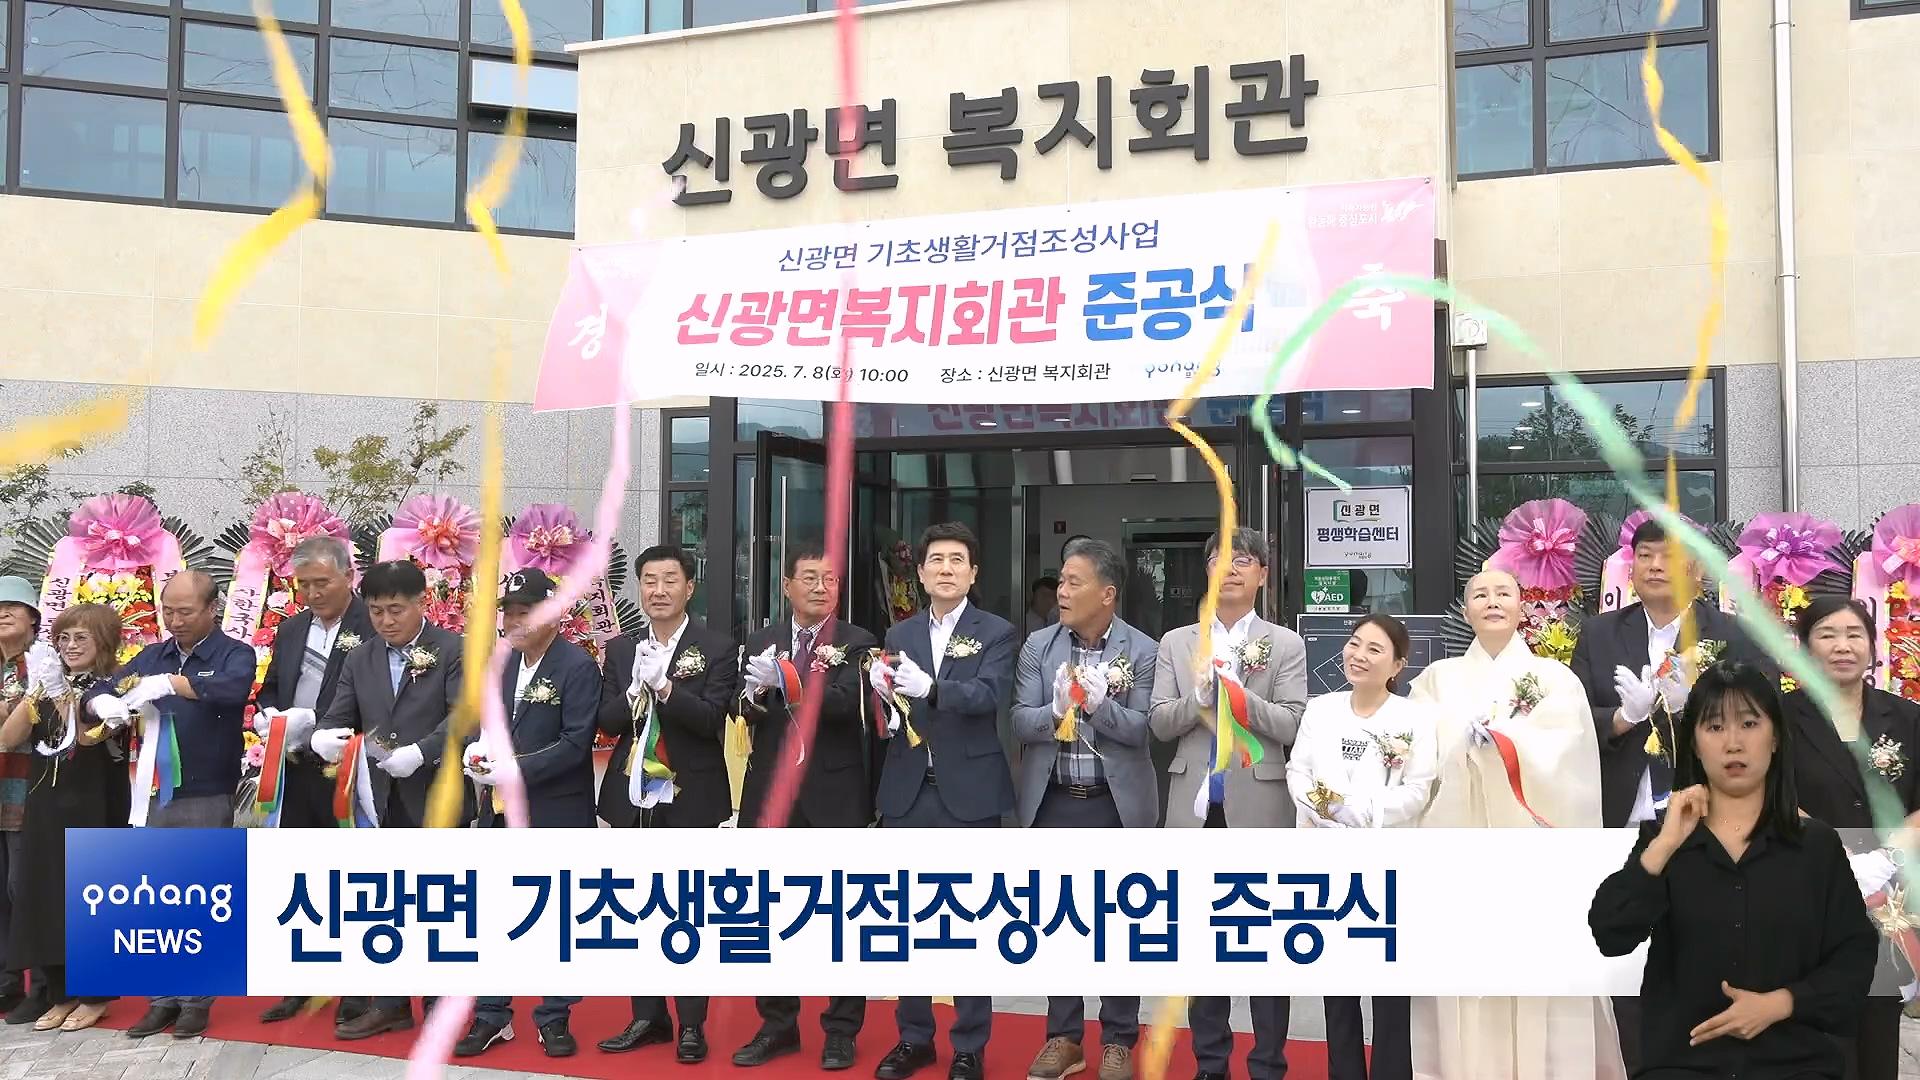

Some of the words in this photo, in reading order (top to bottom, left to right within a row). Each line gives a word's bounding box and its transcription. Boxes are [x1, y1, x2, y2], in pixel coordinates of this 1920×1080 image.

[661, 98, 899, 206] 신광면
[943, 54, 1319, 181] 복지회관
[778, 242, 858, 271] 신광면
[867, 219, 1159, 267] 기초생활거점조성사업
[677, 276, 1066, 348] 신광면복지회관
[1082, 262, 1257, 342] 준공식
[567, 302, 609, 360] 경
[695, 361, 725, 378] 일시
[738, 364, 788, 379] 2025.
[859, 368, 909, 383] 10:00
[940, 366, 972, 384] 장소
[987, 364, 1037, 383] 신광면
[1043, 362, 1111, 383] 복지회관
[1340, 503, 1381, 517] 신광면
[1317, 526, 1400, 542] 평생학습센터
[1324, 593, 1344, 602] AED
